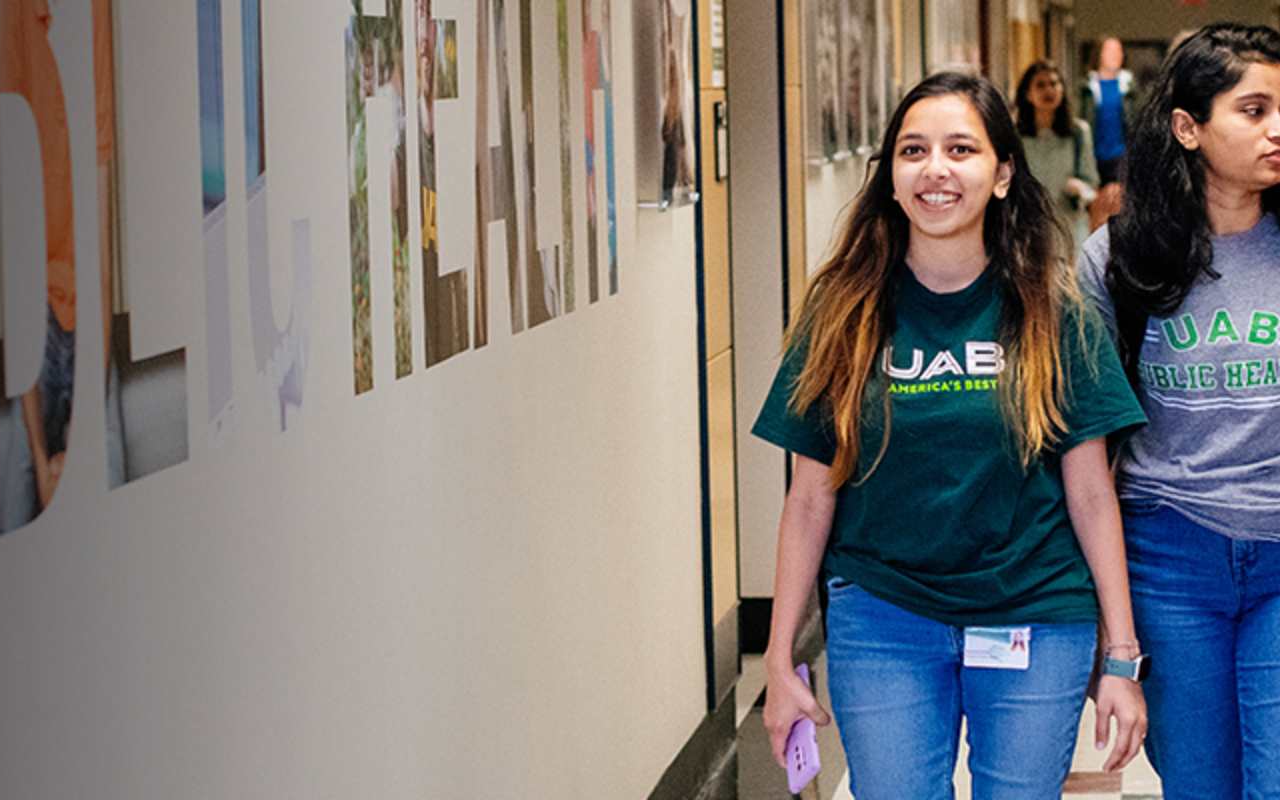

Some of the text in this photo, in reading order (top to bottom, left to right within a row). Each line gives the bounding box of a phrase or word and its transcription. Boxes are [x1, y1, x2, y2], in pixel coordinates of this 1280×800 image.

[1161, 308, 1280, 351] UAB
[882, 341, 1005, 380] UAB
[888, 378, 997, 394] AMERICA'S BEST
